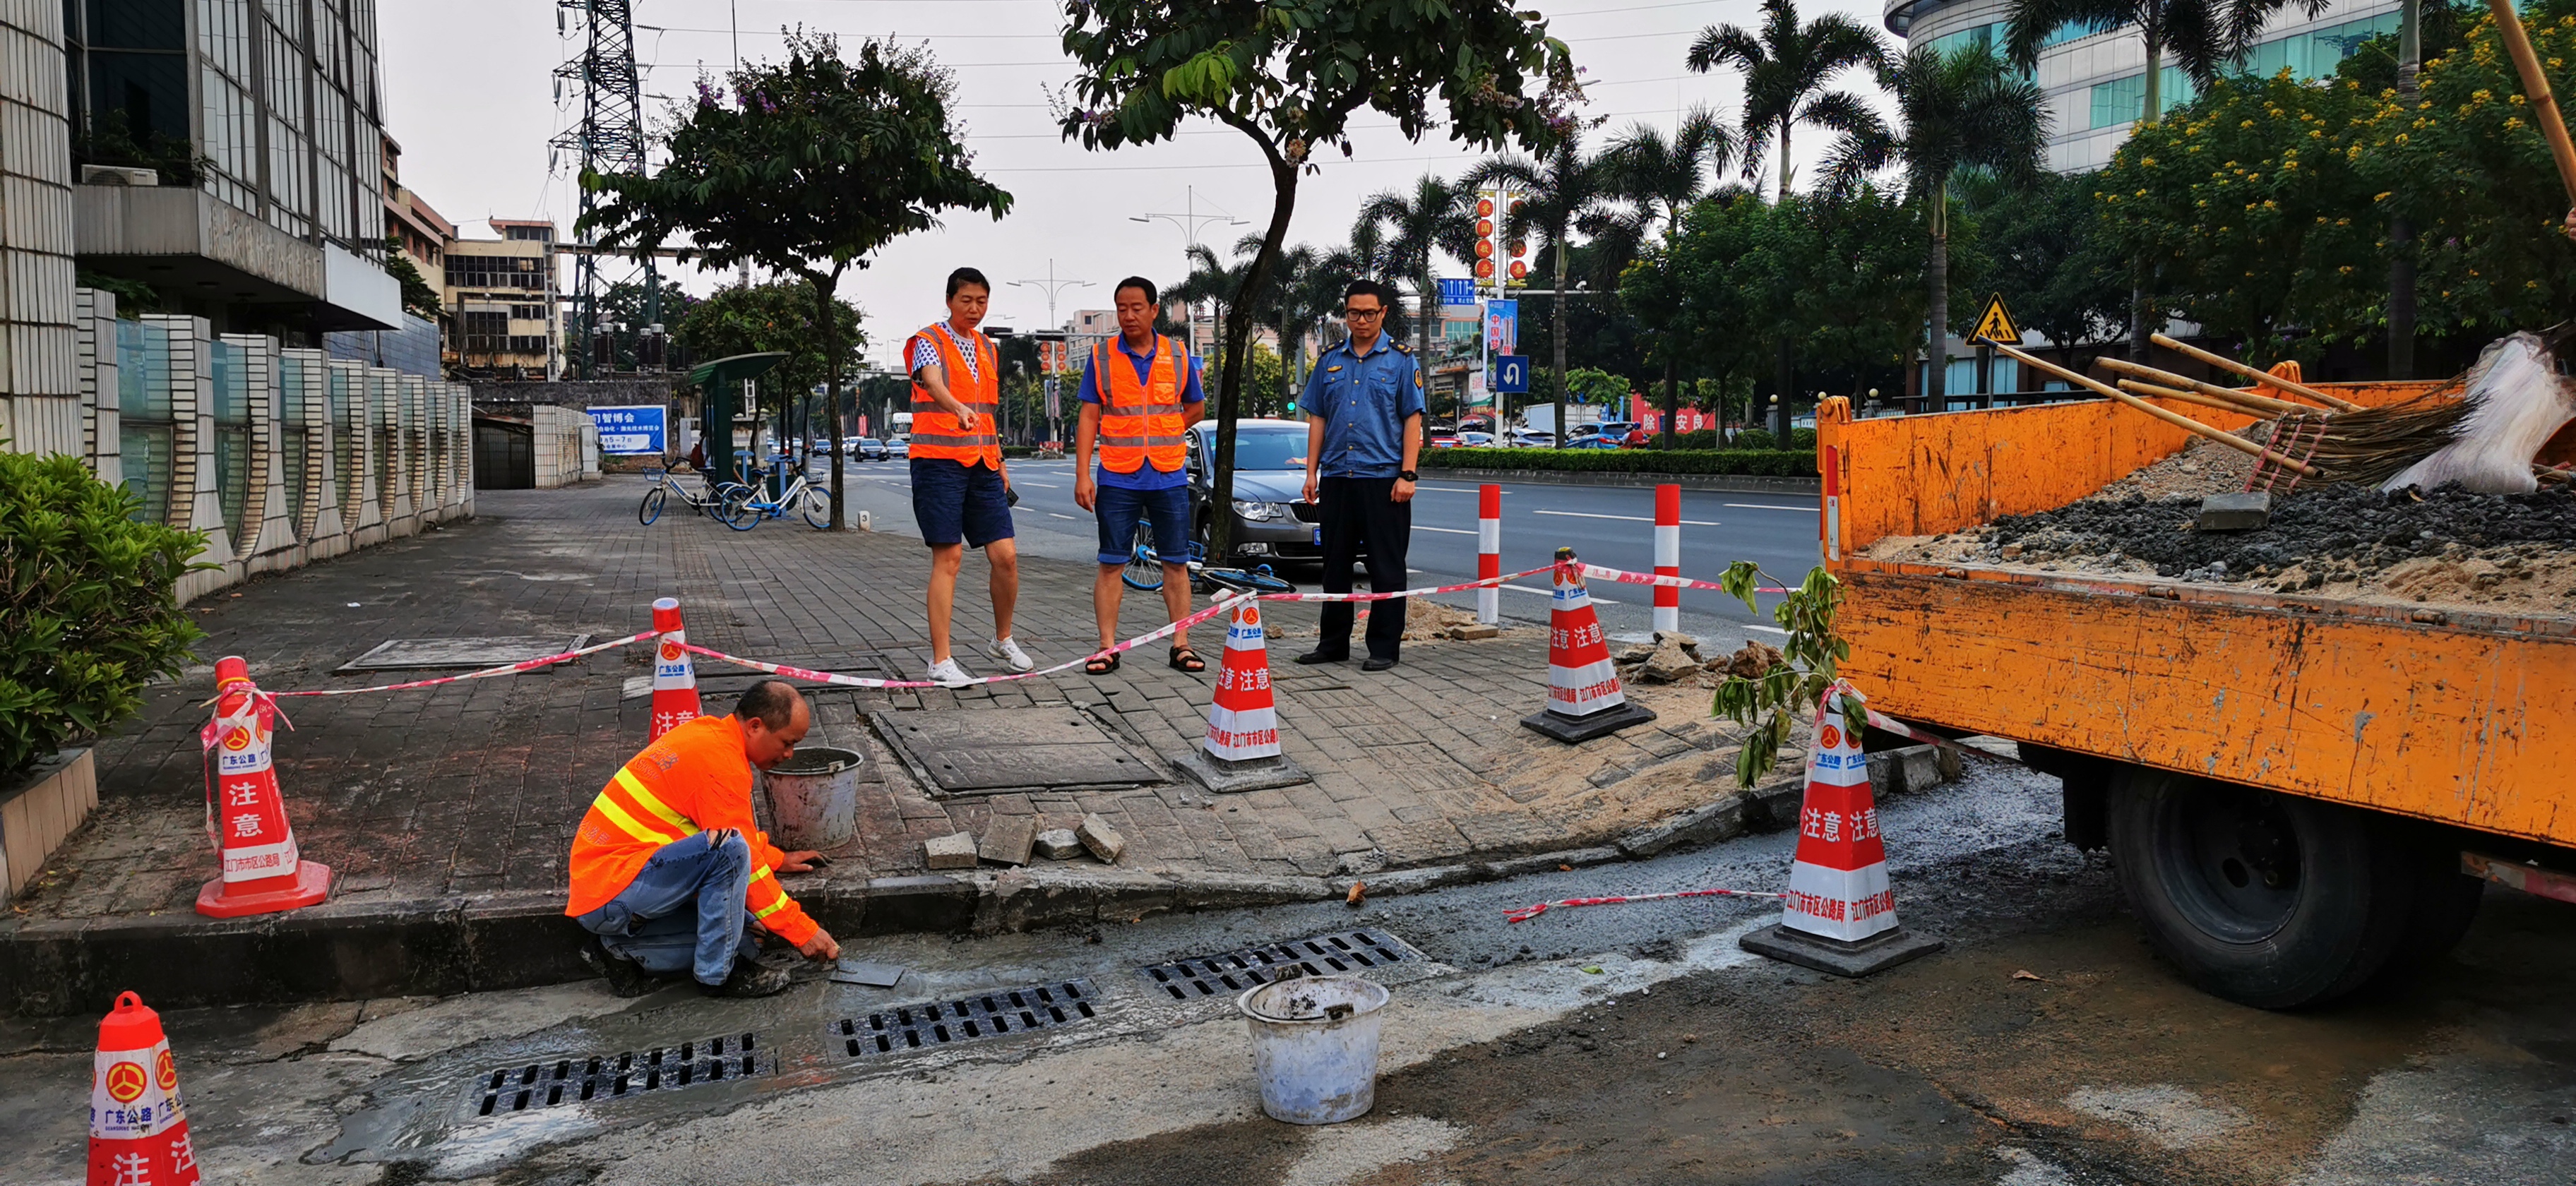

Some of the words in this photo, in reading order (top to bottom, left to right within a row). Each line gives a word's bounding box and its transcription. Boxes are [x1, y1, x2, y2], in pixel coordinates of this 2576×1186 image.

[1643, 414, 1703, 431] 除安良
[1574, 622, 1603, 649] 注意
[659, 664, 684, 674] 广东公路
[1240, 667, 1270, 692] 注意
[222, 753, 256, 765] 广东公路
[228, 781, 264, 838] 注意
[1803, 807, 1842, 843] 注意
[1849, 806, 1879, 843] 注意
[1787, 889, 1846, 923] 江门市市区公路局
[105, 1106, 153, 1125] 广东公路
